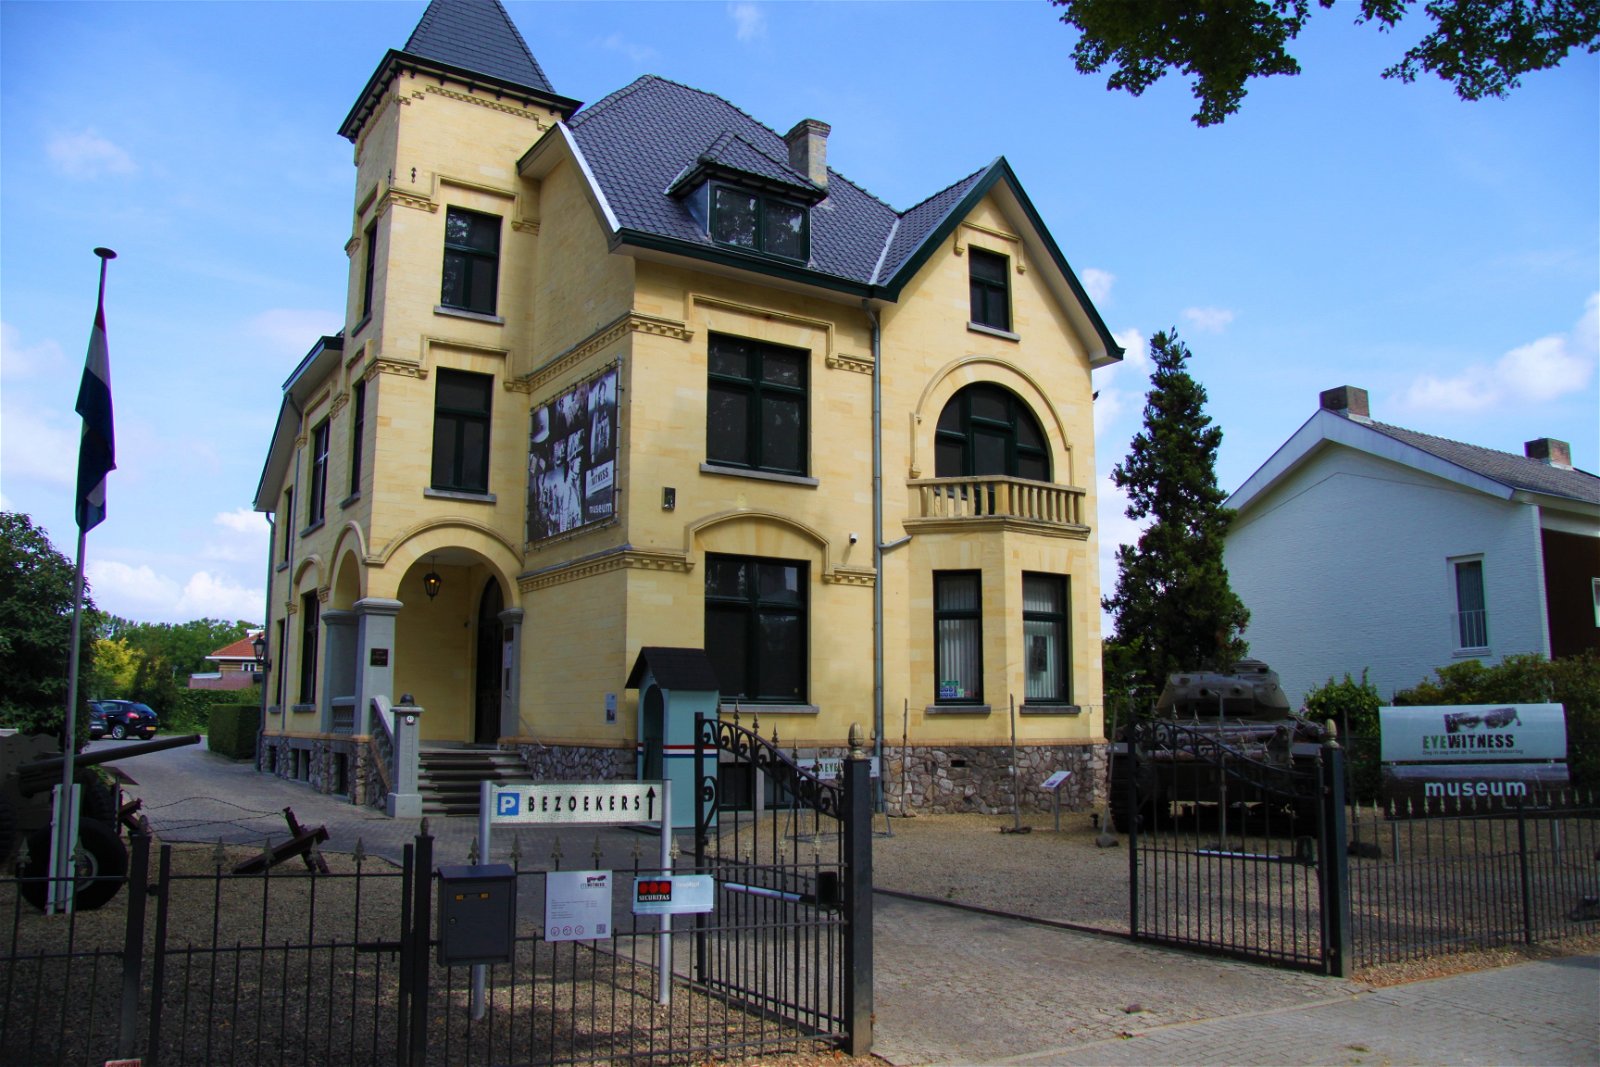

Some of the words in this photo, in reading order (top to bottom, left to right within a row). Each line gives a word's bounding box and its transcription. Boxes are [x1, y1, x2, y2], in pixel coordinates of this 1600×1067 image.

[1423, 734, 1514, 749] EYEWITNESS
[1425, 782, 1526, 796] museum
[501, 796, 516, 813] P
[528, 795, 640, 812] BEZOEKERS
